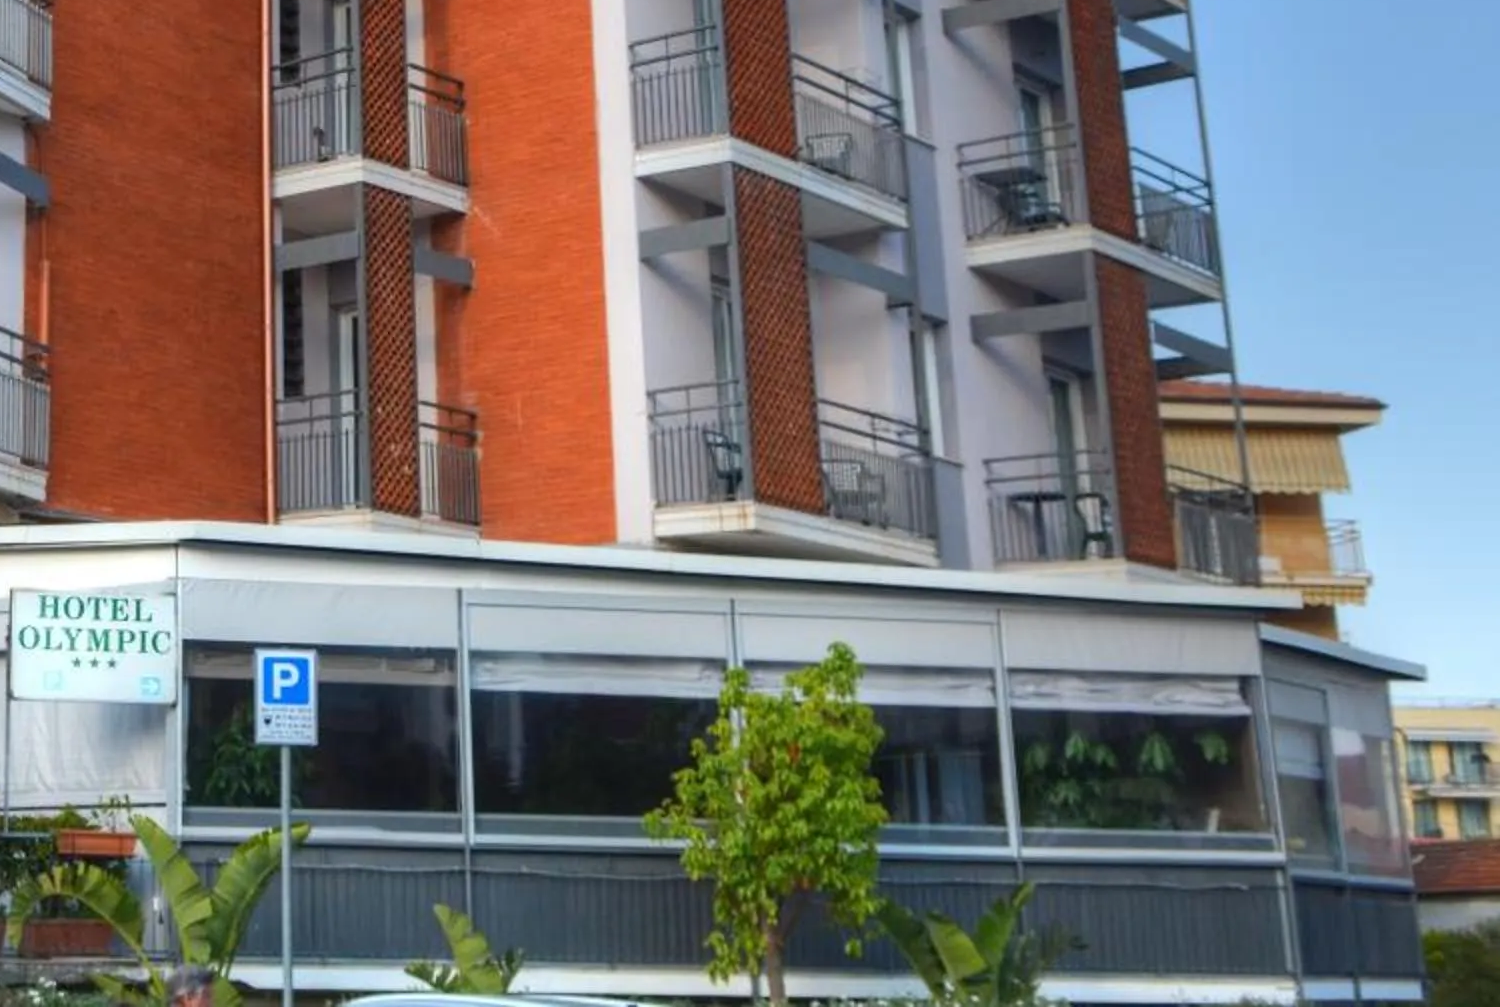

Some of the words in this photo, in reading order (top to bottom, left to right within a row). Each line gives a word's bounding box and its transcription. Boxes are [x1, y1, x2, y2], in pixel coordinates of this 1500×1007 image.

[38, 594, 153, 623] HOTEL
[18, 625, 171, 654] OLYMPIC
[273, 662, 300, 700] P
